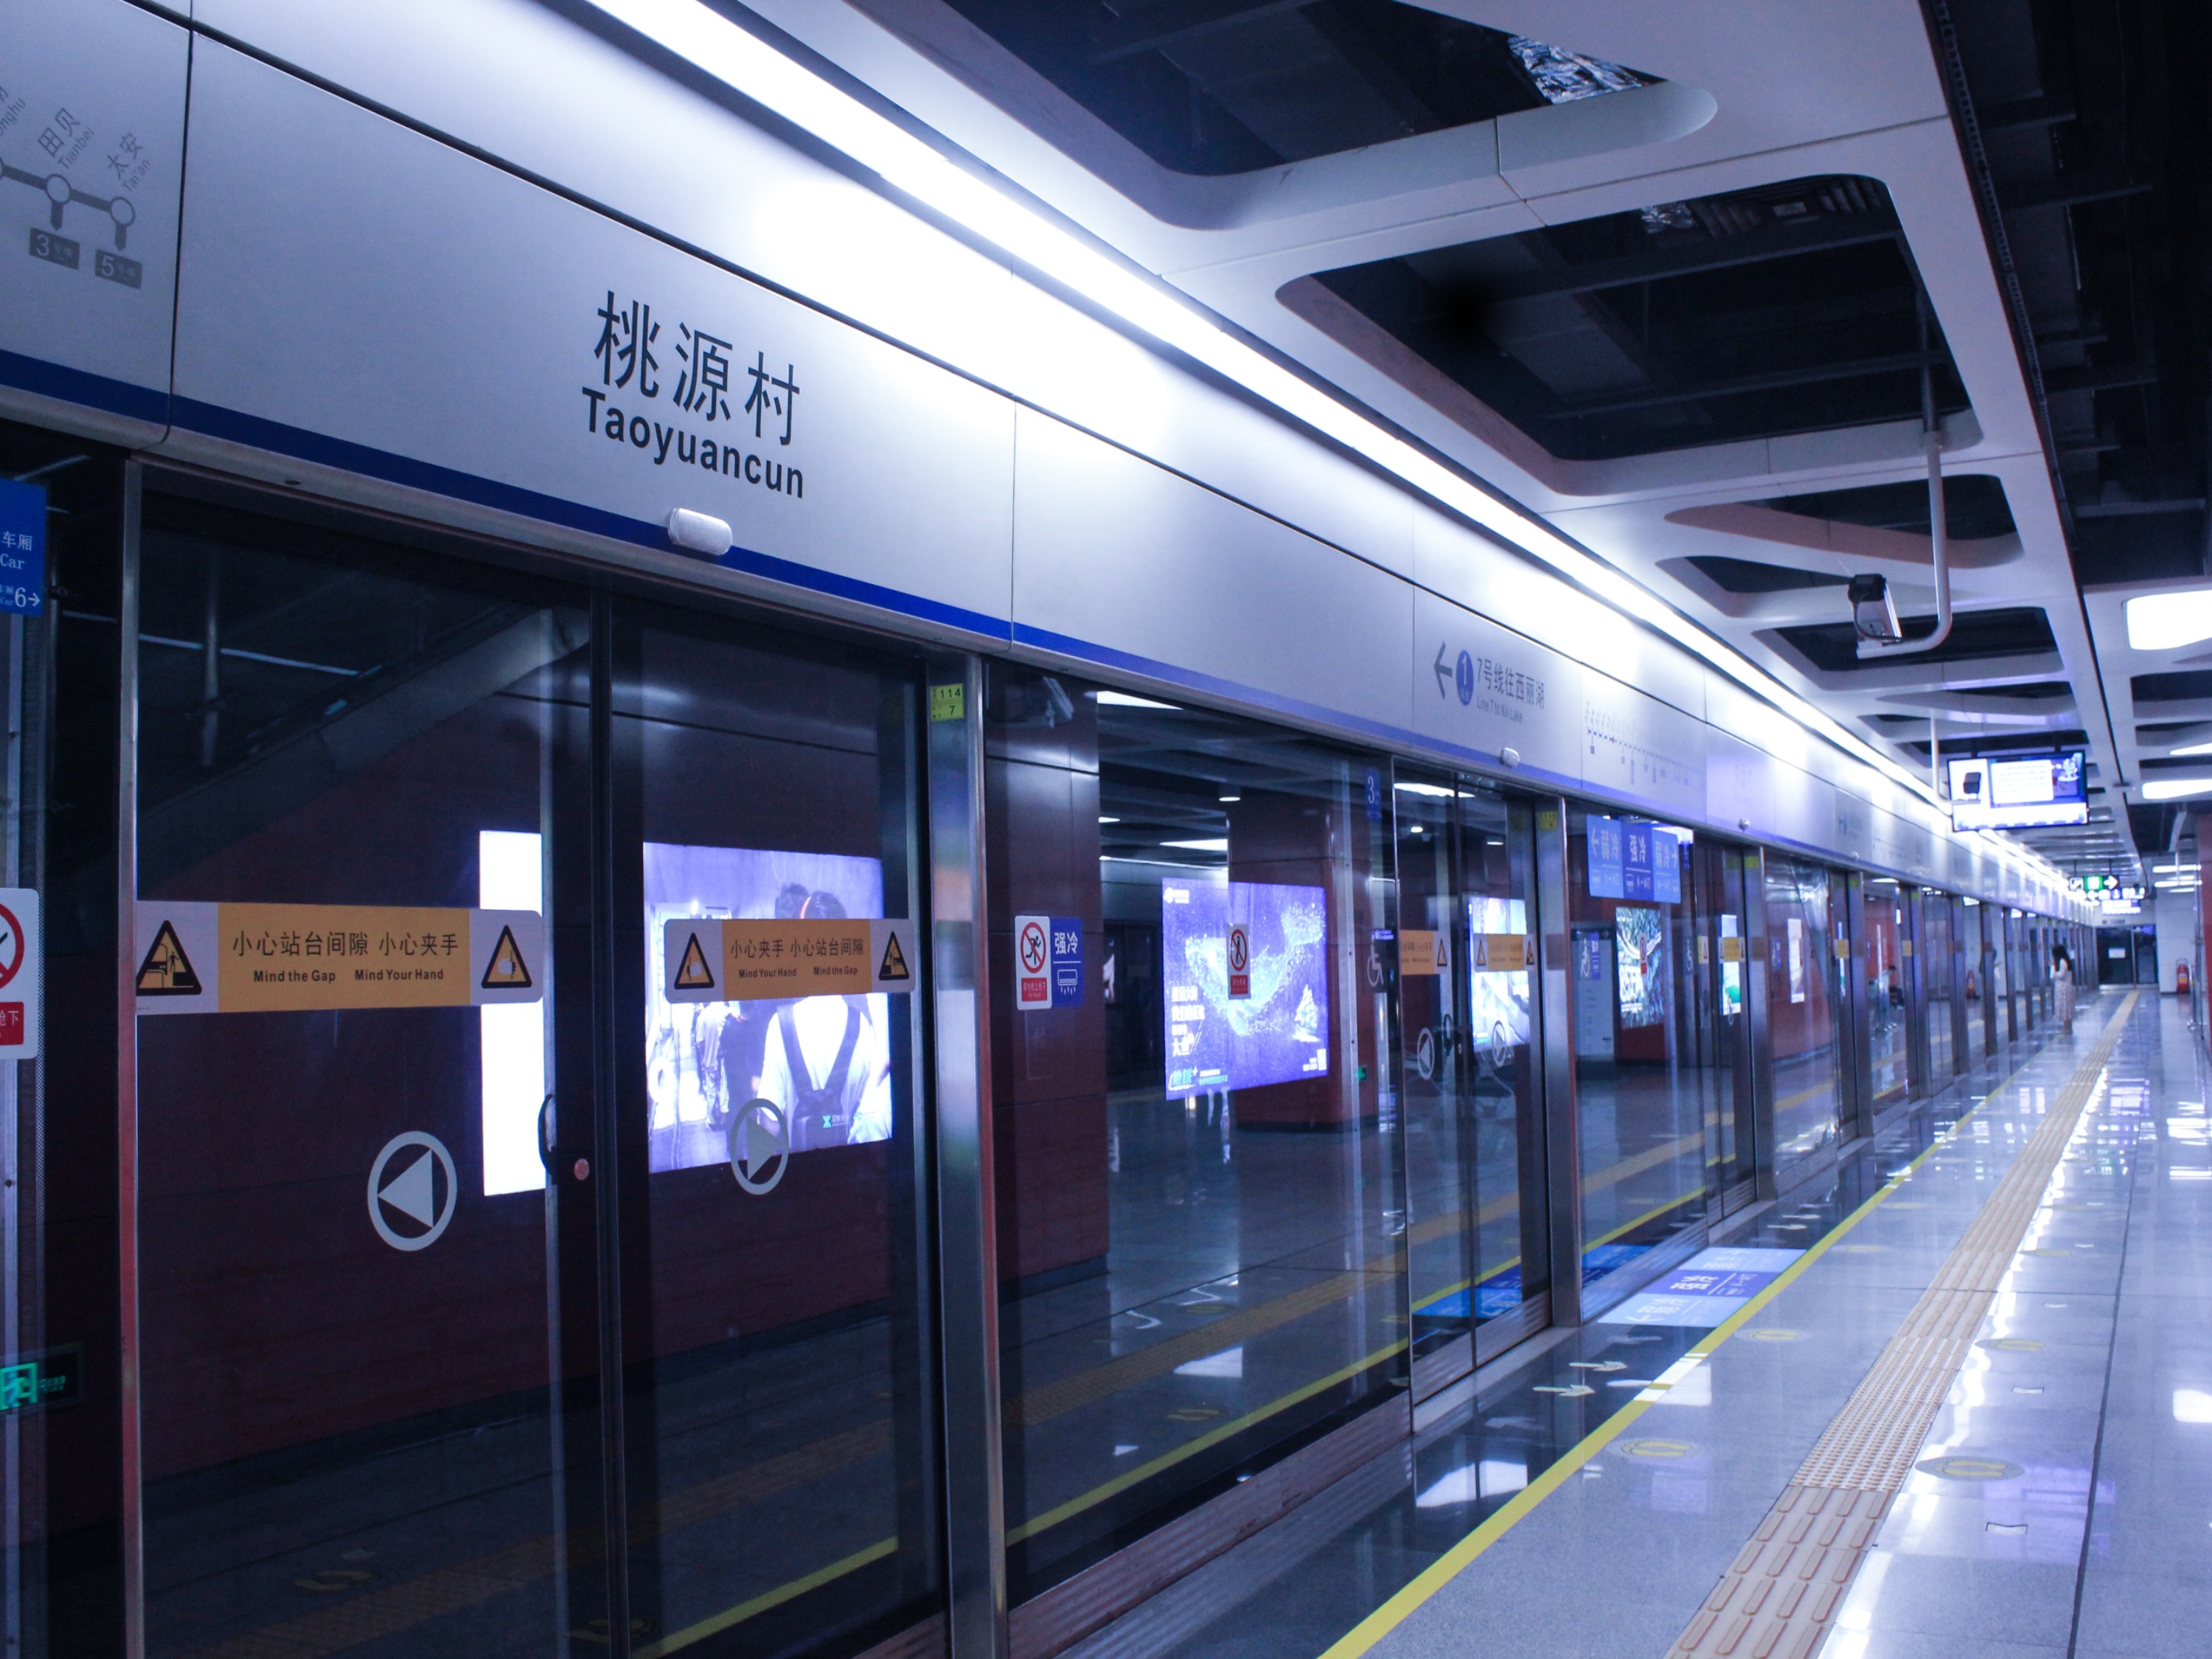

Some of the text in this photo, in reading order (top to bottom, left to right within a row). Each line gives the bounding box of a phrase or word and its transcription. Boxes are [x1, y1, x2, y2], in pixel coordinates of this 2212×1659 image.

[38, 108, 80, 158] 田贝
[58, 126, 94, 170] Tianbei
[107, 133, 142, 179] 太安
[123, 158, 151, 192] Tai'an
[36, 234, 49, 257] 3
[101, 255, 114, 277] 5
[594, 290, 800, 445] 桃源村
[582, 386, 803, 498] Taoyuancun
[1, 531, 32, 552] 车厢
[0, 554, 25, 570] Car
[15, 587, 27, 608] 6
[940, 687, 961, 699] 114
[949, 705, 955, 715] 7
[1368, 776, 1374, 804] 3
[232, 931, 459, 958] 小心站台间隙 小心夹手
[730, 937, 864, 959] 小心夹手 小心站台间隙
[1054, 931, 1078, 955] 强冷
[254, 970, 336, 984] Mind the Gap
[355, 969, 444, 981] Mind Your Hand
[739, 967, 797, 978] Mind Your Hand
[813, 966, 858, 977] Mind the Gap
